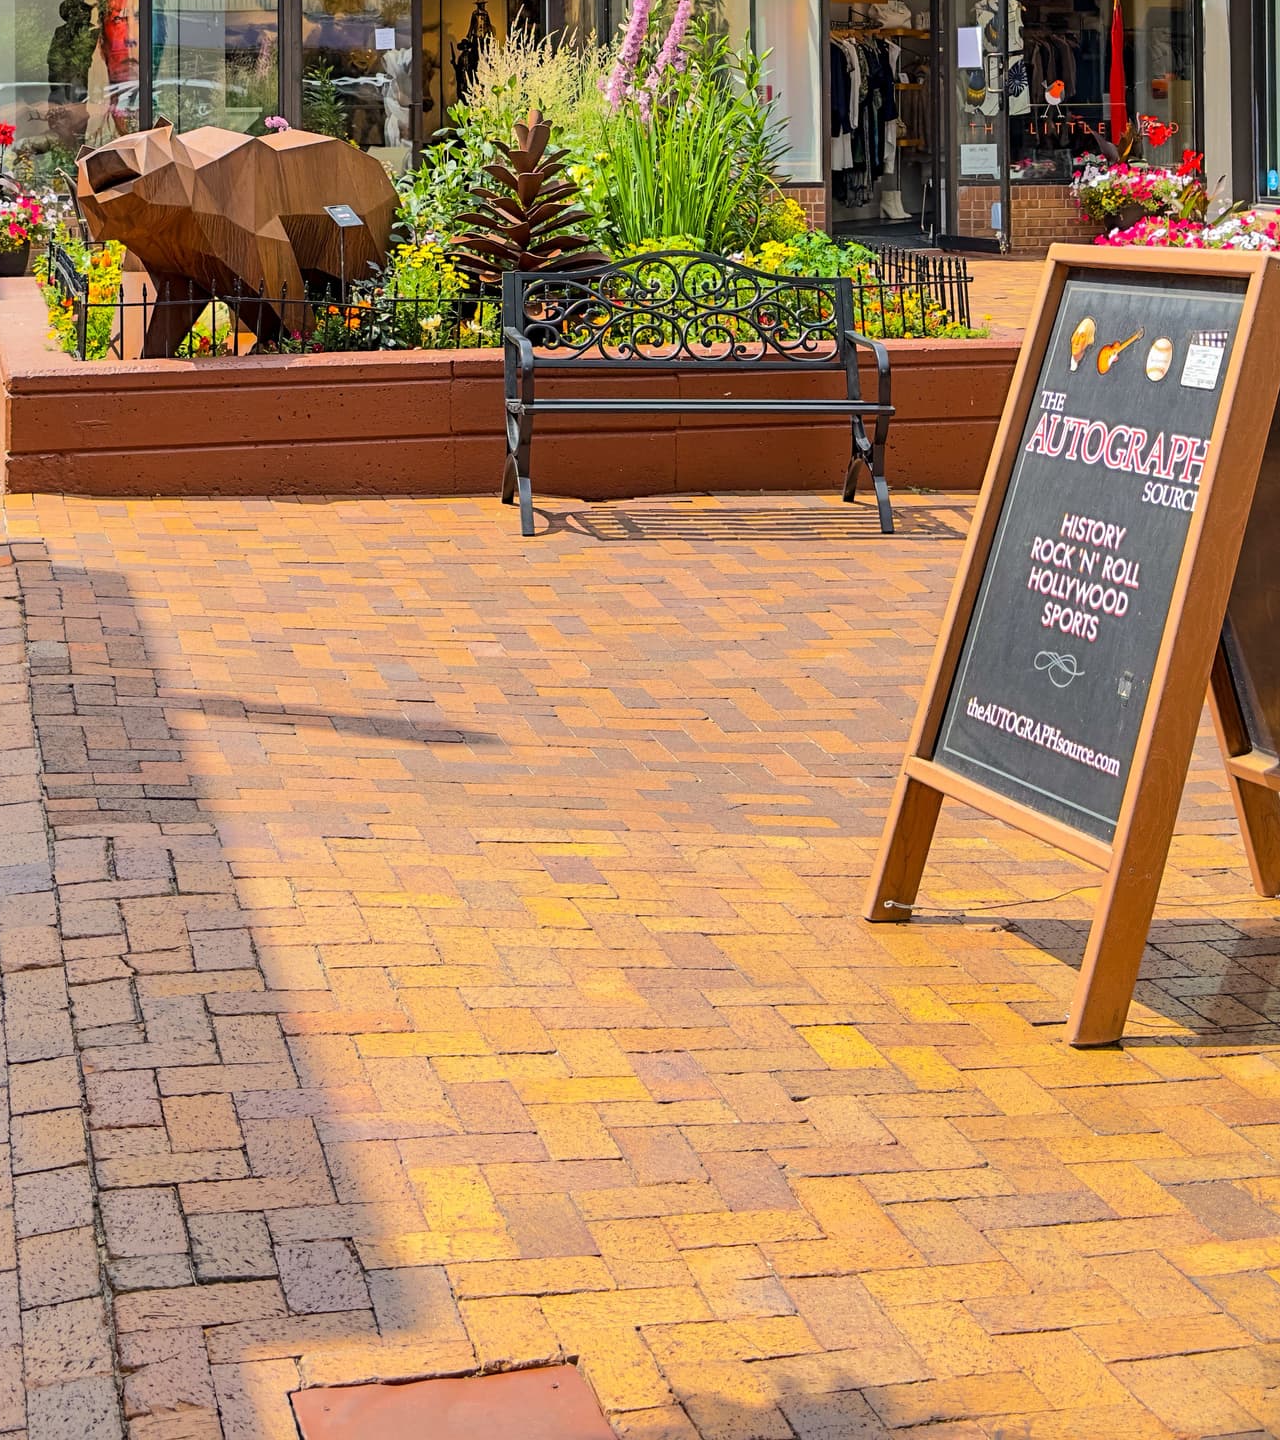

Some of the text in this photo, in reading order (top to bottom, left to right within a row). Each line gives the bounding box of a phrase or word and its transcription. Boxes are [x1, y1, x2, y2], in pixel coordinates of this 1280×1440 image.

[1030, 122, 1105, 136] LITTLE
[1040, 391, 1066, 411] THE
[1025, 412, 1211, 485] AUTOGRAPH
[1060, 512, 1127, 550] HISTORY
[1031, 536, 1139, 589] ROCK 'N' ROLL
[1027, 566, 1128, 617] HOLLYWOOD
[1041, 601, 1099, 642] SPORTS
[966, 696, 1120, 777] theAUTOGRAPHsource.com
